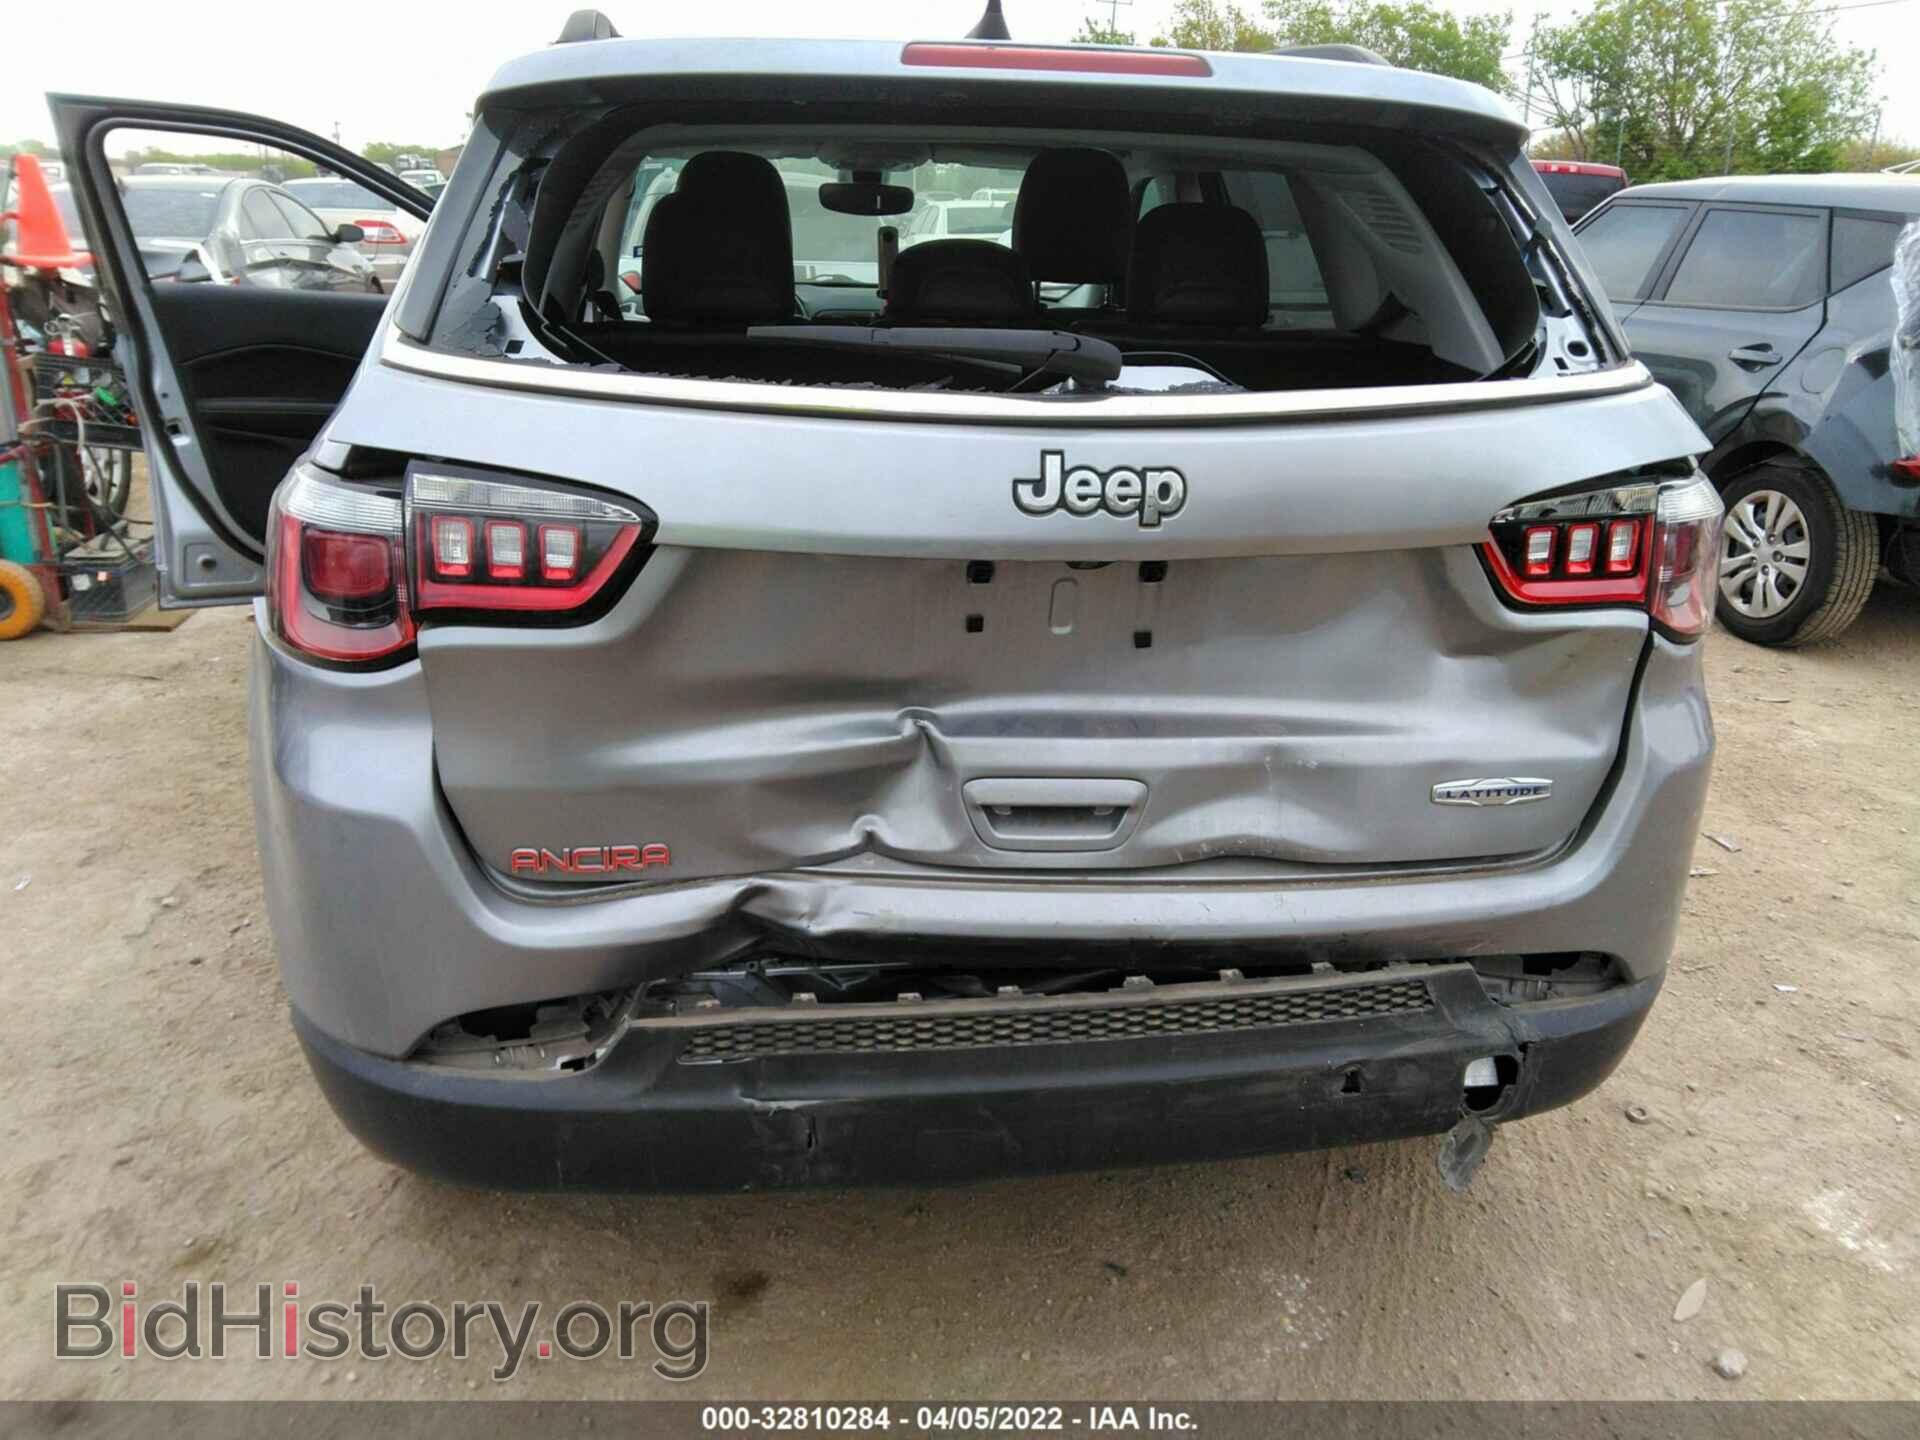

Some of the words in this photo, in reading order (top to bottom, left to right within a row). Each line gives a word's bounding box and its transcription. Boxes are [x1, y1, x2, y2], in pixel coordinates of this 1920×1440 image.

[1013, 450, 1187, 526] Jeep
[1445, 786, 1543, 799] LATITUDE
[511, 844, 670, 873] ANCIRA
